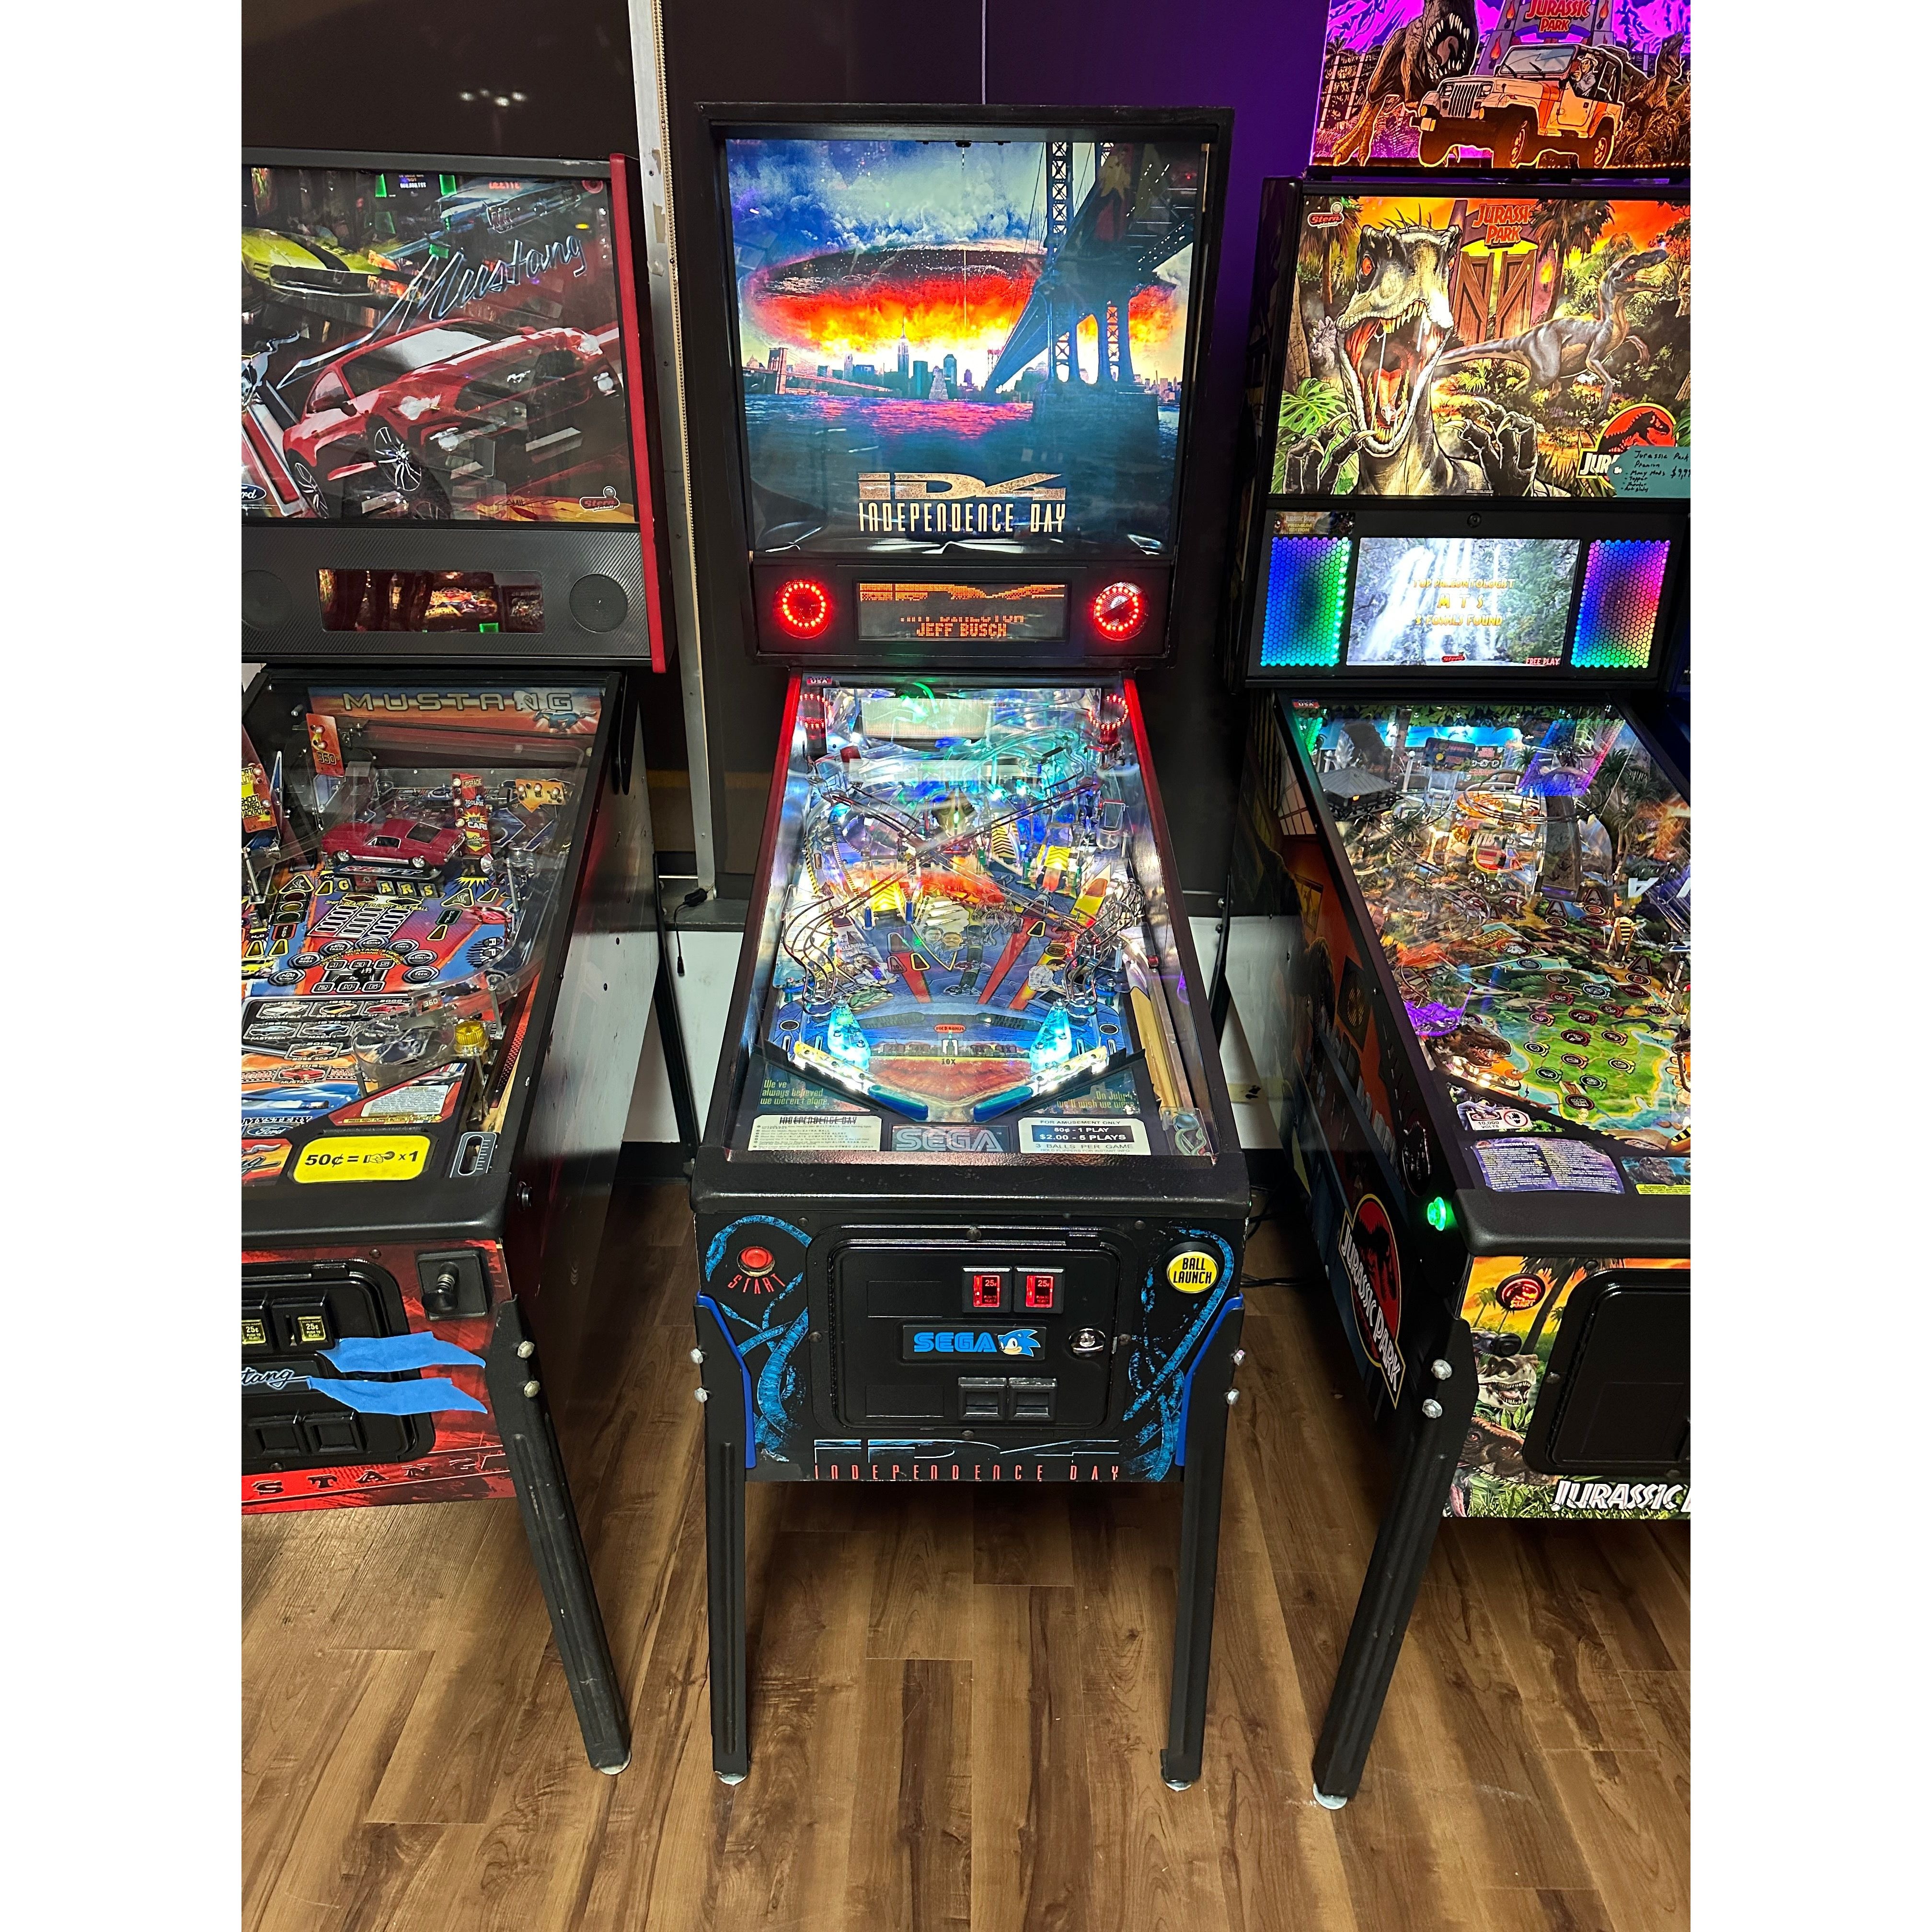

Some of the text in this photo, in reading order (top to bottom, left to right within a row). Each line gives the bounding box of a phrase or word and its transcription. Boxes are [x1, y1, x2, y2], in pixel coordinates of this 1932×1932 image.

[1525, 0, 1591, 19] JURASSIC
[1539, 18, 1570, 33] PARK
[1485, 225, 1522, 245] PARK
[395, 235, 586, 331] Mustang
[1634, 450, 1668, 459] Jurassic
[858, 472, 1066, 501] ID4
[584, 499, 615, 507] Stern
[859, 503, 1066, 532] INDEPENDENCE DAY
[1413, 578, 1432, 588] TOP
[1467, 614, 1503, 626] FOUND
[917, 623, 1007, 637] JEFF BUSCH
[343, 692, 574, 712] MUSTANG
[462, 779, 483, 788] UPGRADE
[340, 866, 424, 874] SHIFT
[764, 1079, 787, 1088] We've
[762, 1088, 823, 1098] always believed
[1096, 1091, 1126, 1103] On July
[1078, 1100, 1098, 1108] wish
[242, 1116, 312, 1126] MYSTERY
[841, 1116, 857, 1125] DAY
[254, 1127, 287, 1135] Ford
[896, 1129, 1004, 1151] SEGA
[305, 1154, 344, 1168] 50¢
[1182, 1257, 1206, 1270] BALL
[728, 1273, 786, 1294] START
[1173, 1271, 1212, 1284] LAUNCH
[1342, 1224, 1400, 1391] JURASSIC PARK
[914, 1332, 997, 1352] SEGA
[815, 1465, 1119, 1481] INDEPENDENCE DAY
[1549, 1481, 1683, 1511] JURASSIC
